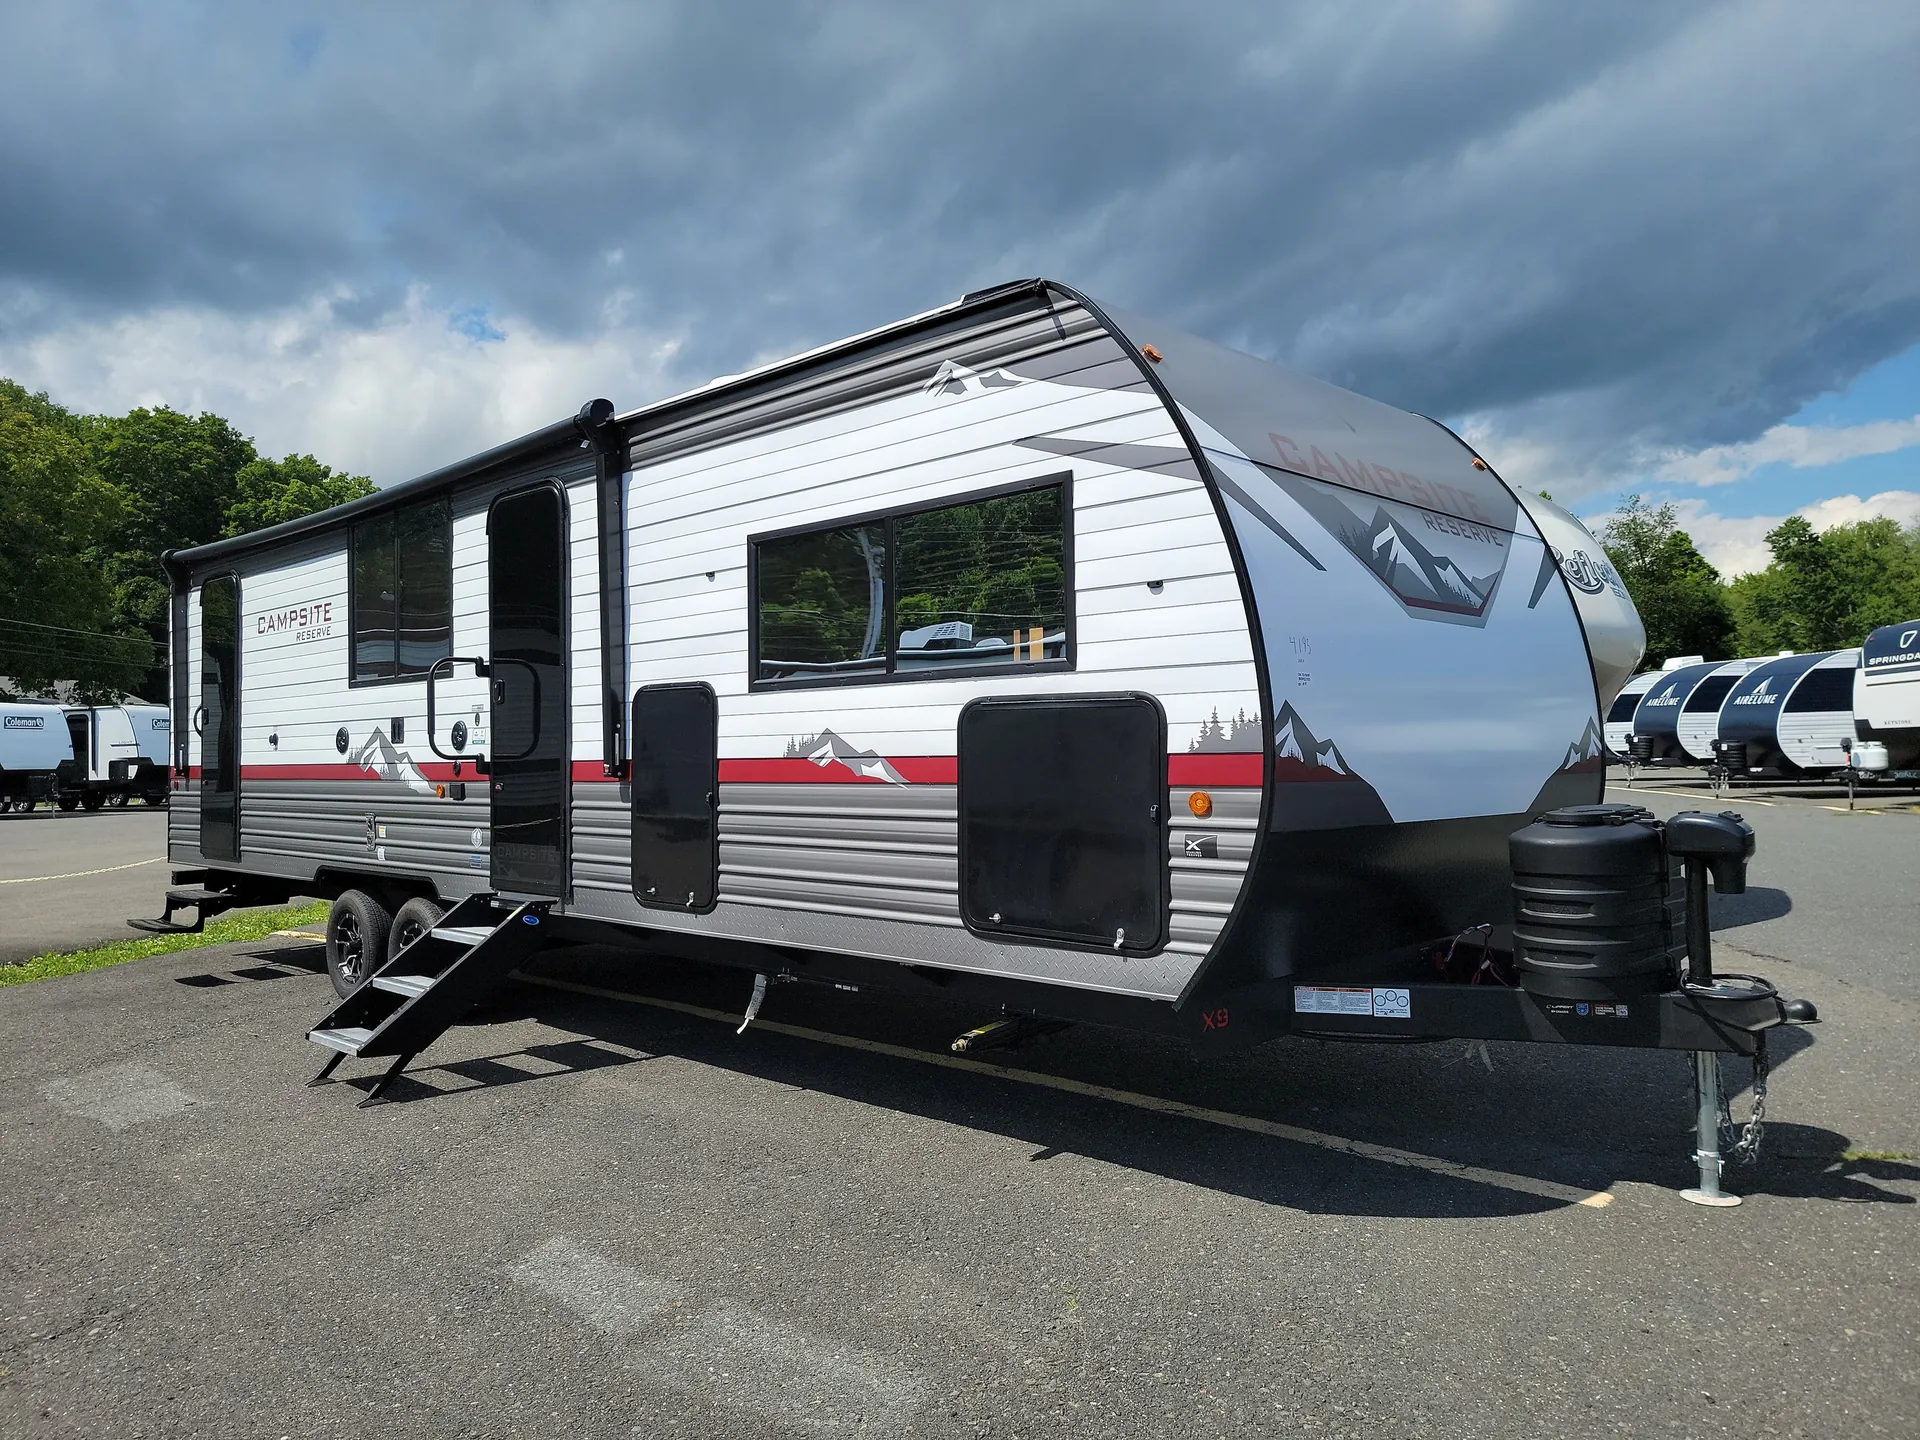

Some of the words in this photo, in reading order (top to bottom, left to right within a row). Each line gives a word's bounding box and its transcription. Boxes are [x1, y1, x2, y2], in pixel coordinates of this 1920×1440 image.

[1268, 432, 1492, 523] CAMPSITE
[1421, 512, 1504, 547] RESERVE
[258, 602, 332, 634] CAMPSITE
[296, 625, 331, 642] RESERVE
[1645, 697, 1681, 707] AIRELUME
[1733, 693, 1779, 705] AIRELUME
[5, 717, 37, 727] Coleman
[152, 719, 170, 728] Colem
